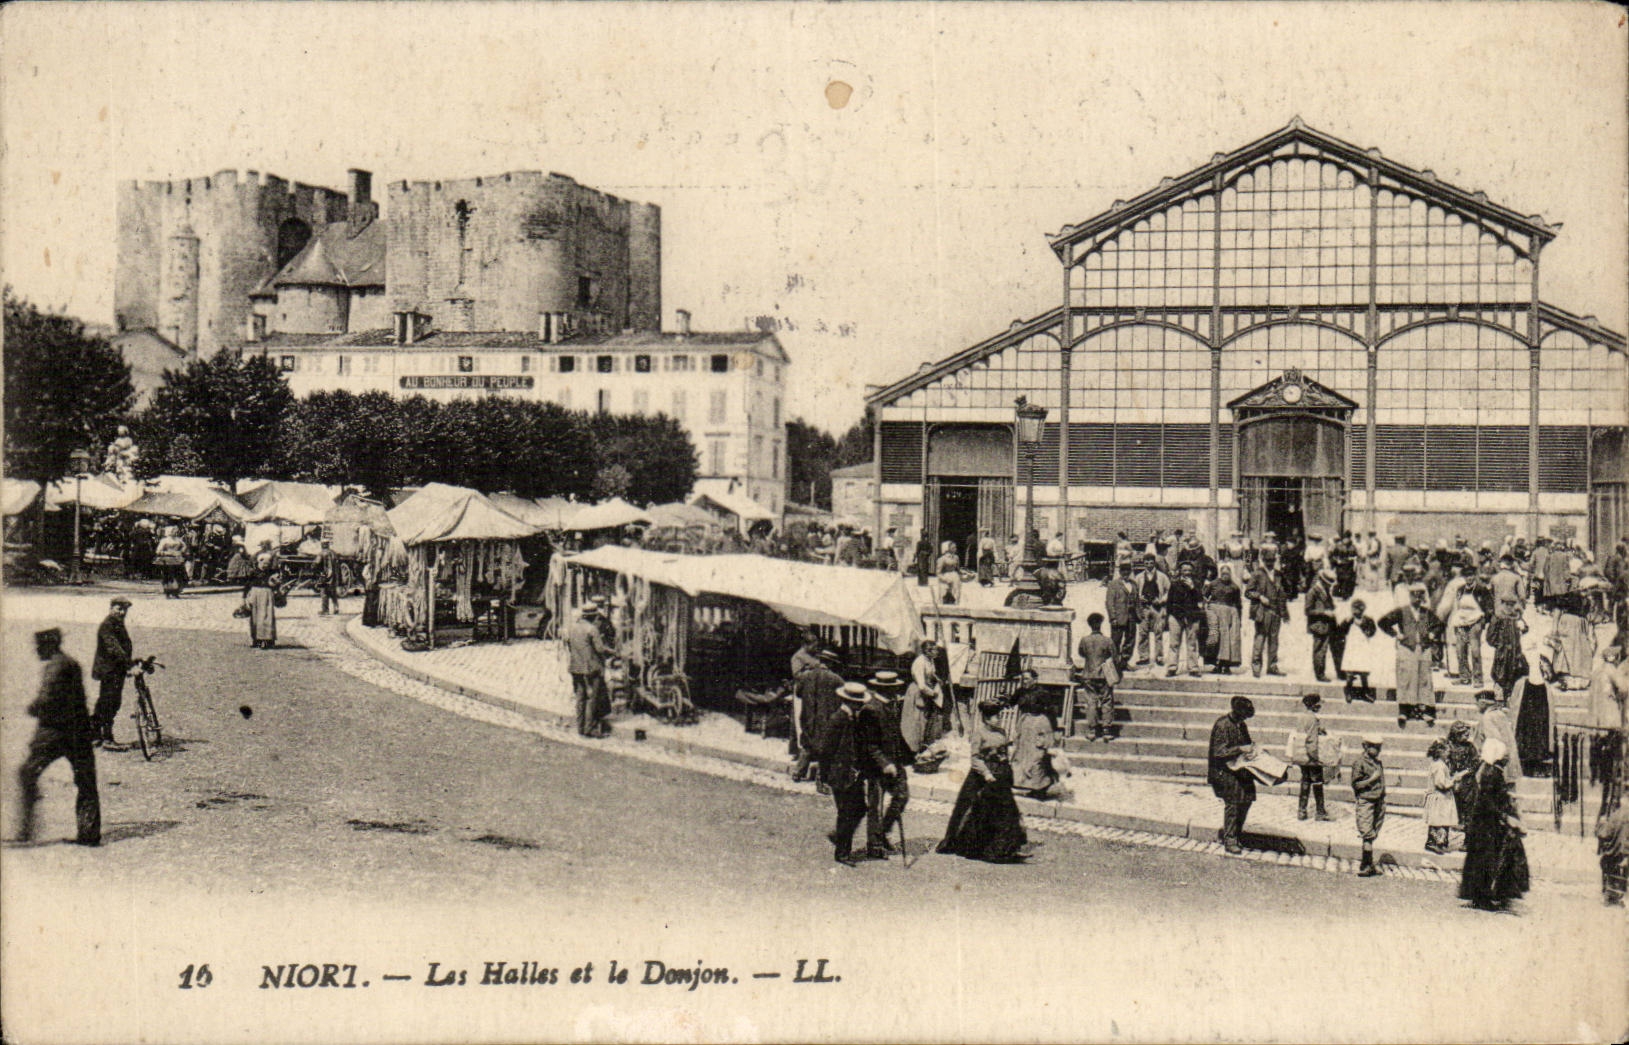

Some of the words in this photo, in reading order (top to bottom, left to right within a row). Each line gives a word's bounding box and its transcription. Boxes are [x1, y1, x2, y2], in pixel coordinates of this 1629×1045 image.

[405, 376, 418, 388] AU
[423, 376, 467, 388] BONHEUR
[471, 376, 485, 388] DU
[489, 376, 529, 388] PEUPLE
